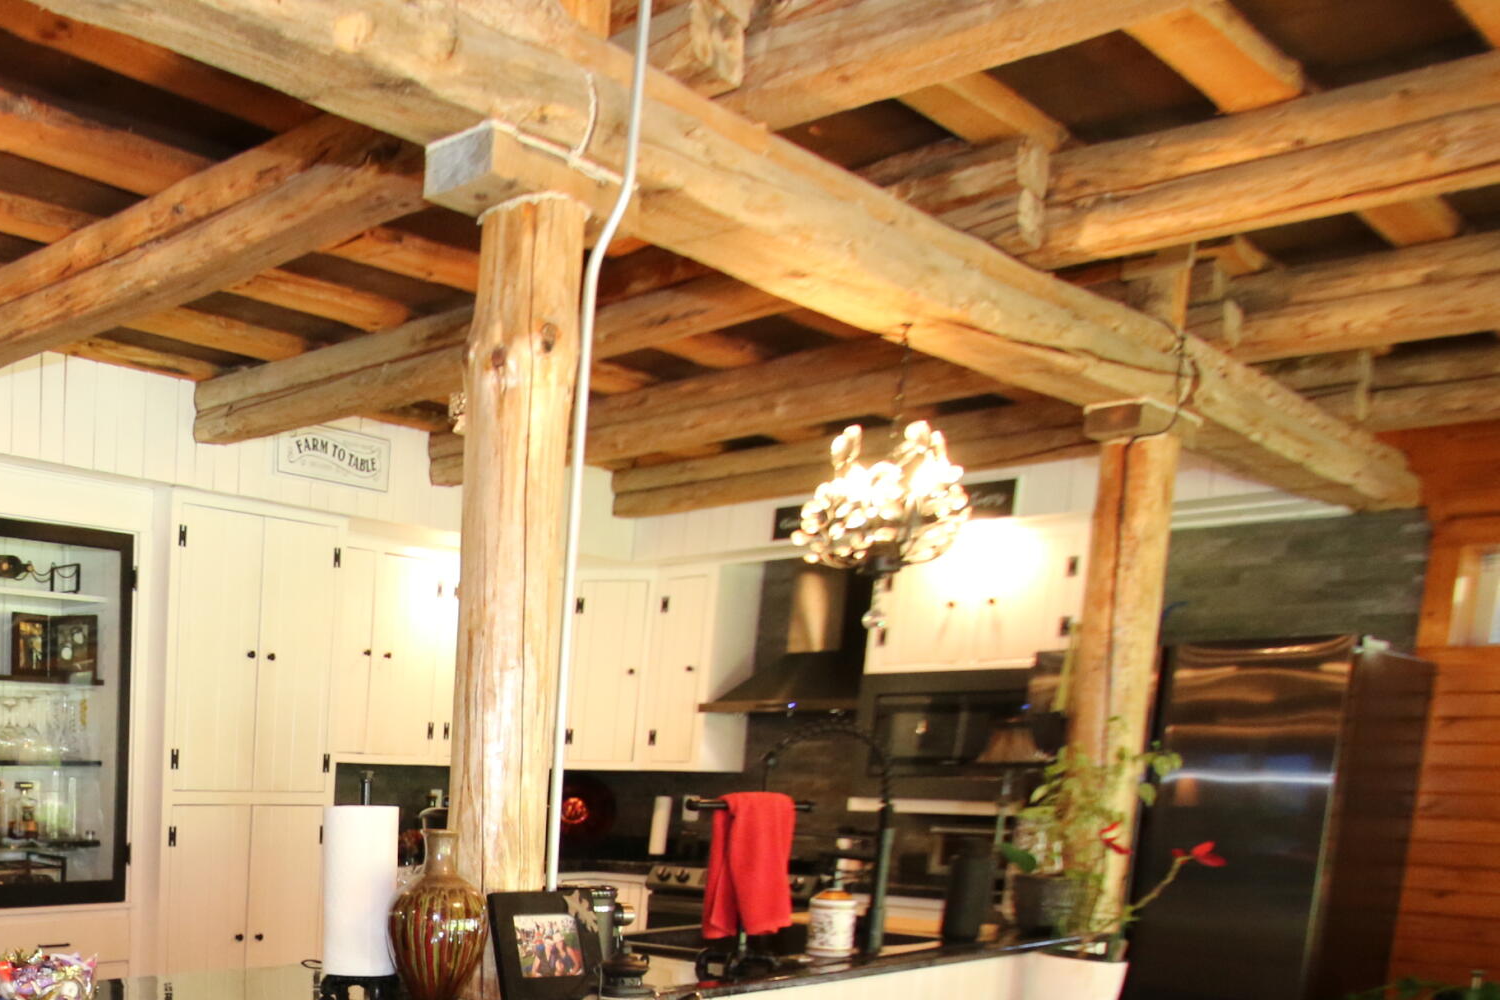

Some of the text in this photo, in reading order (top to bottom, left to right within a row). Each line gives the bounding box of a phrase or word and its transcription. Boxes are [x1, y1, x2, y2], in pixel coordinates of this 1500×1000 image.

[295, 437, 329, 454] FARM
[332, 443, 346, 461] TO
[348, 453, 377, 472] TABLE
